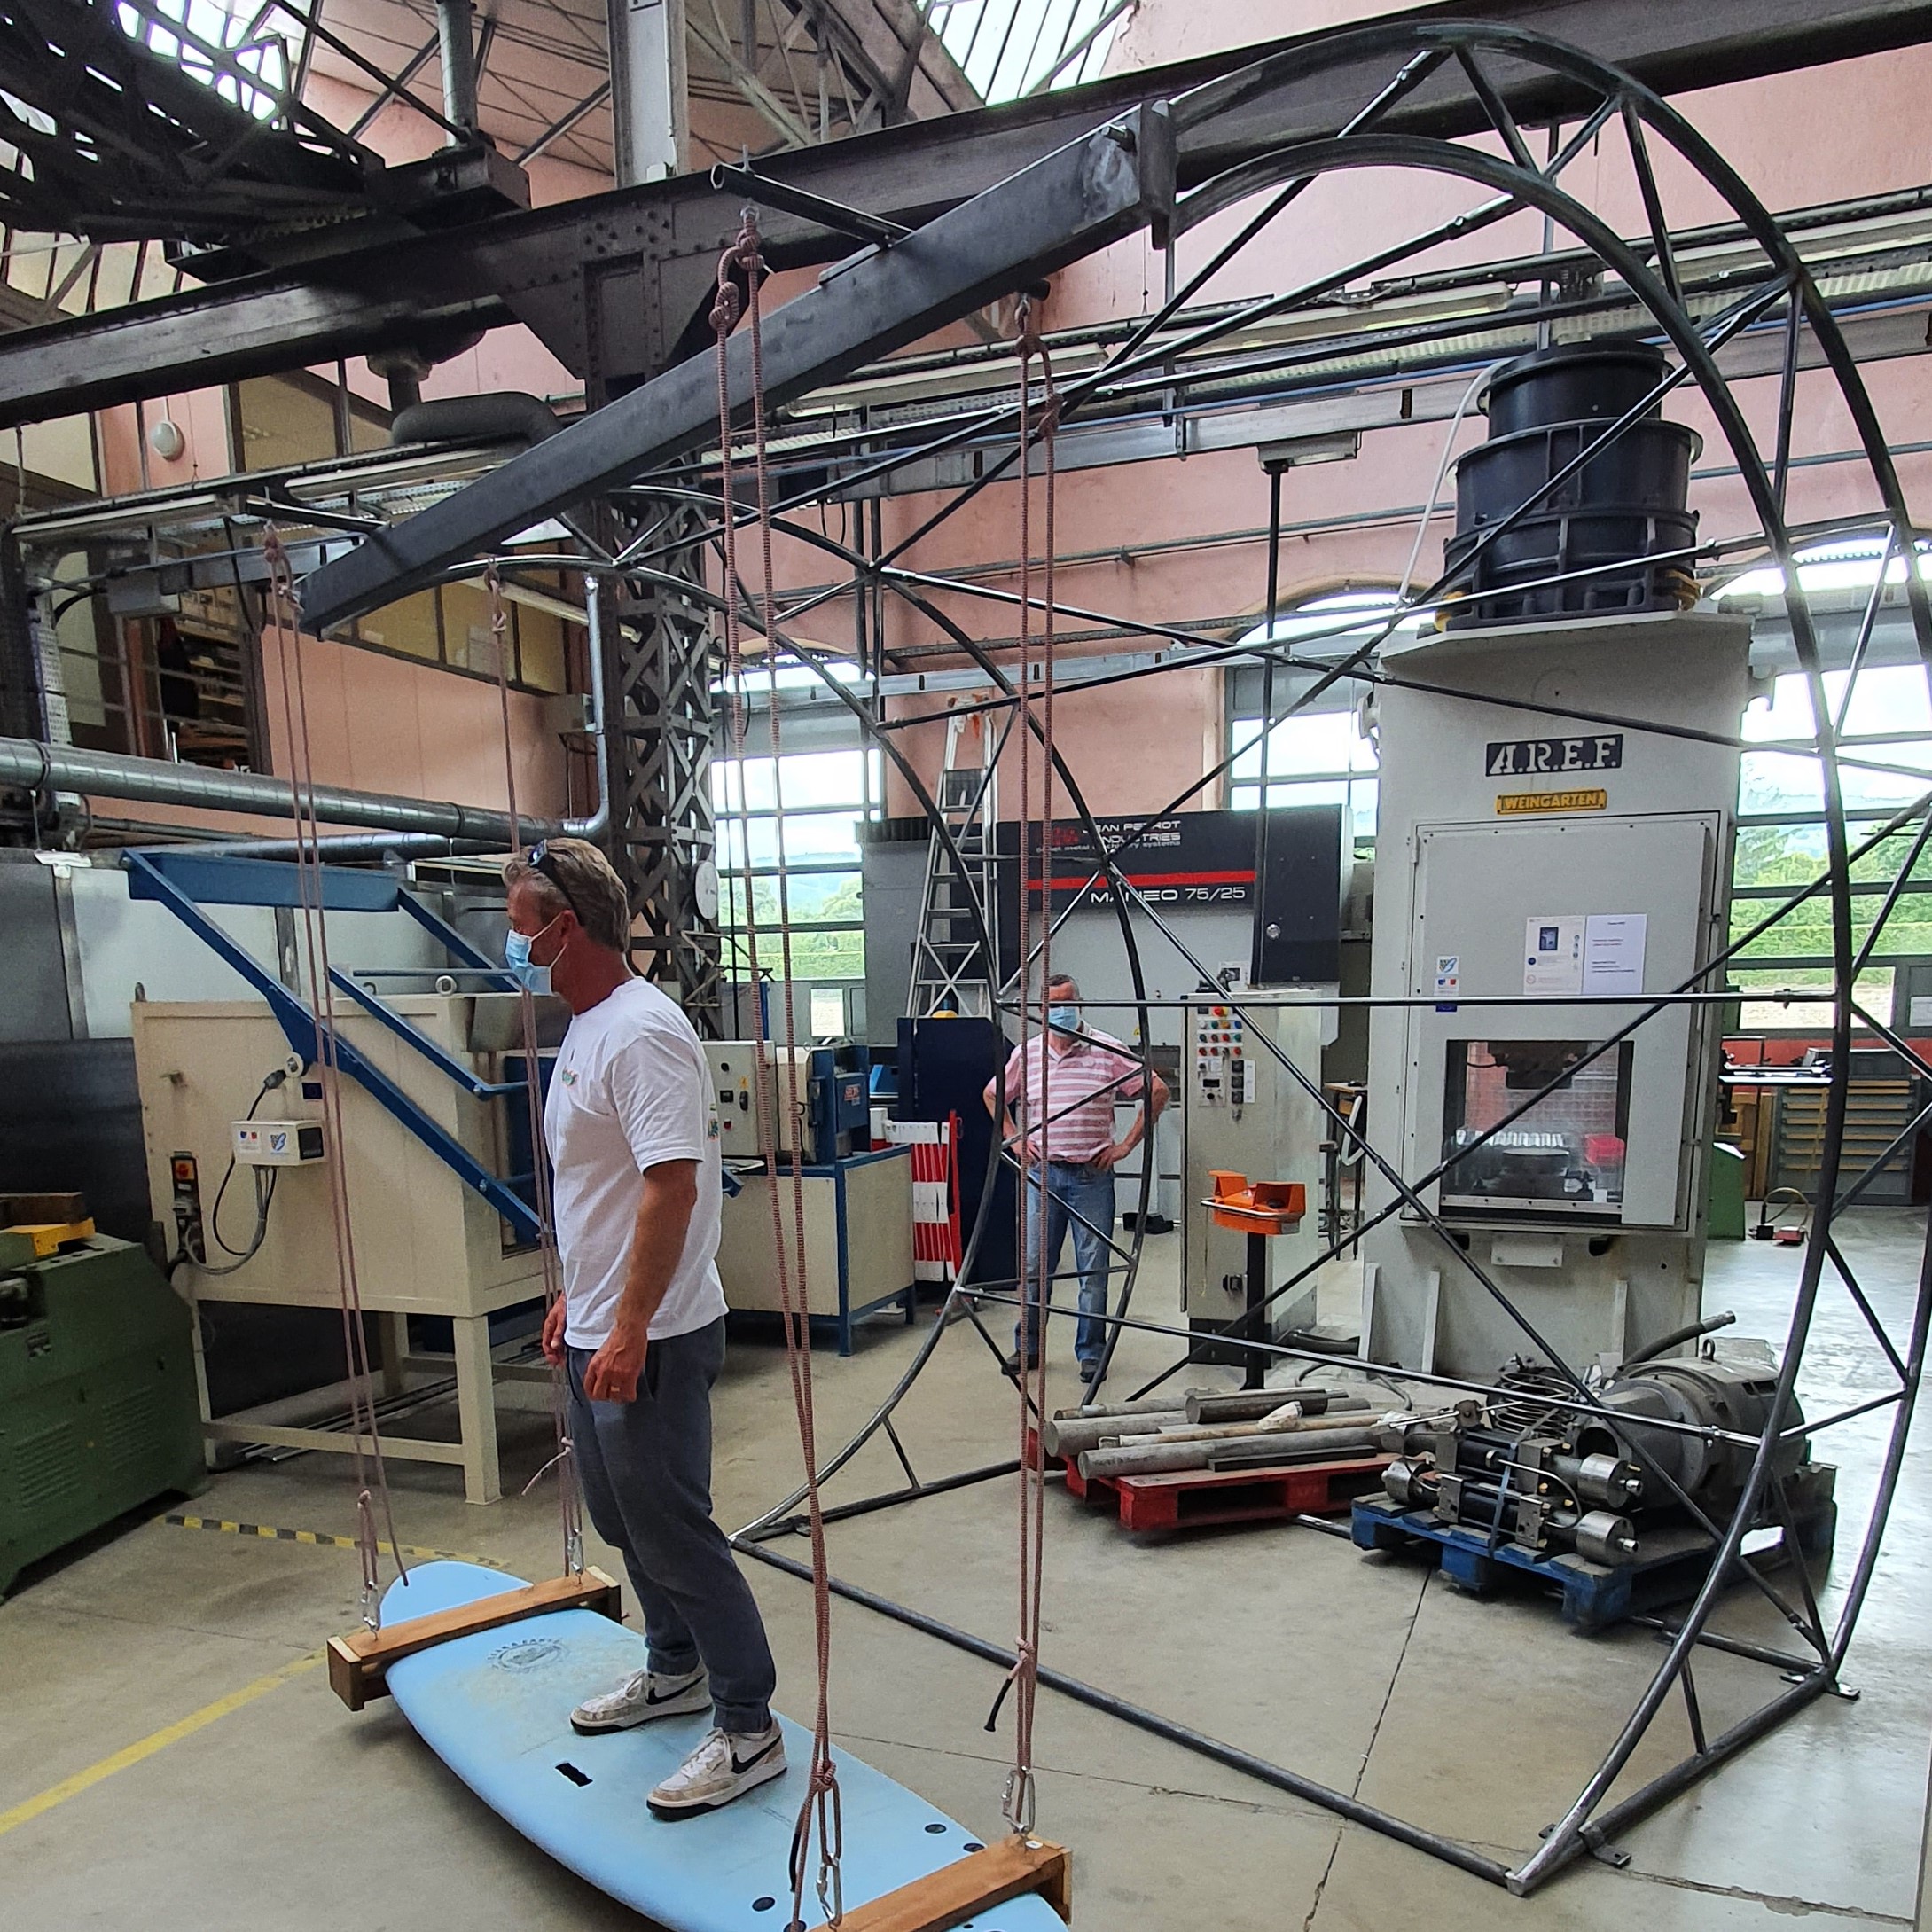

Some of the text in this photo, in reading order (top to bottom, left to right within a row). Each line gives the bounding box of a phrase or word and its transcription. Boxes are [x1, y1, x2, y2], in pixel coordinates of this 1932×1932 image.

[1504, 794, 1596, 810] WEINGARTEN
[1083, 825, 1119, 833] EAN
[1100, 832, 1181, 843] NDUTRIES
[1091, 887, 1246, 903] MNEO 75/25
